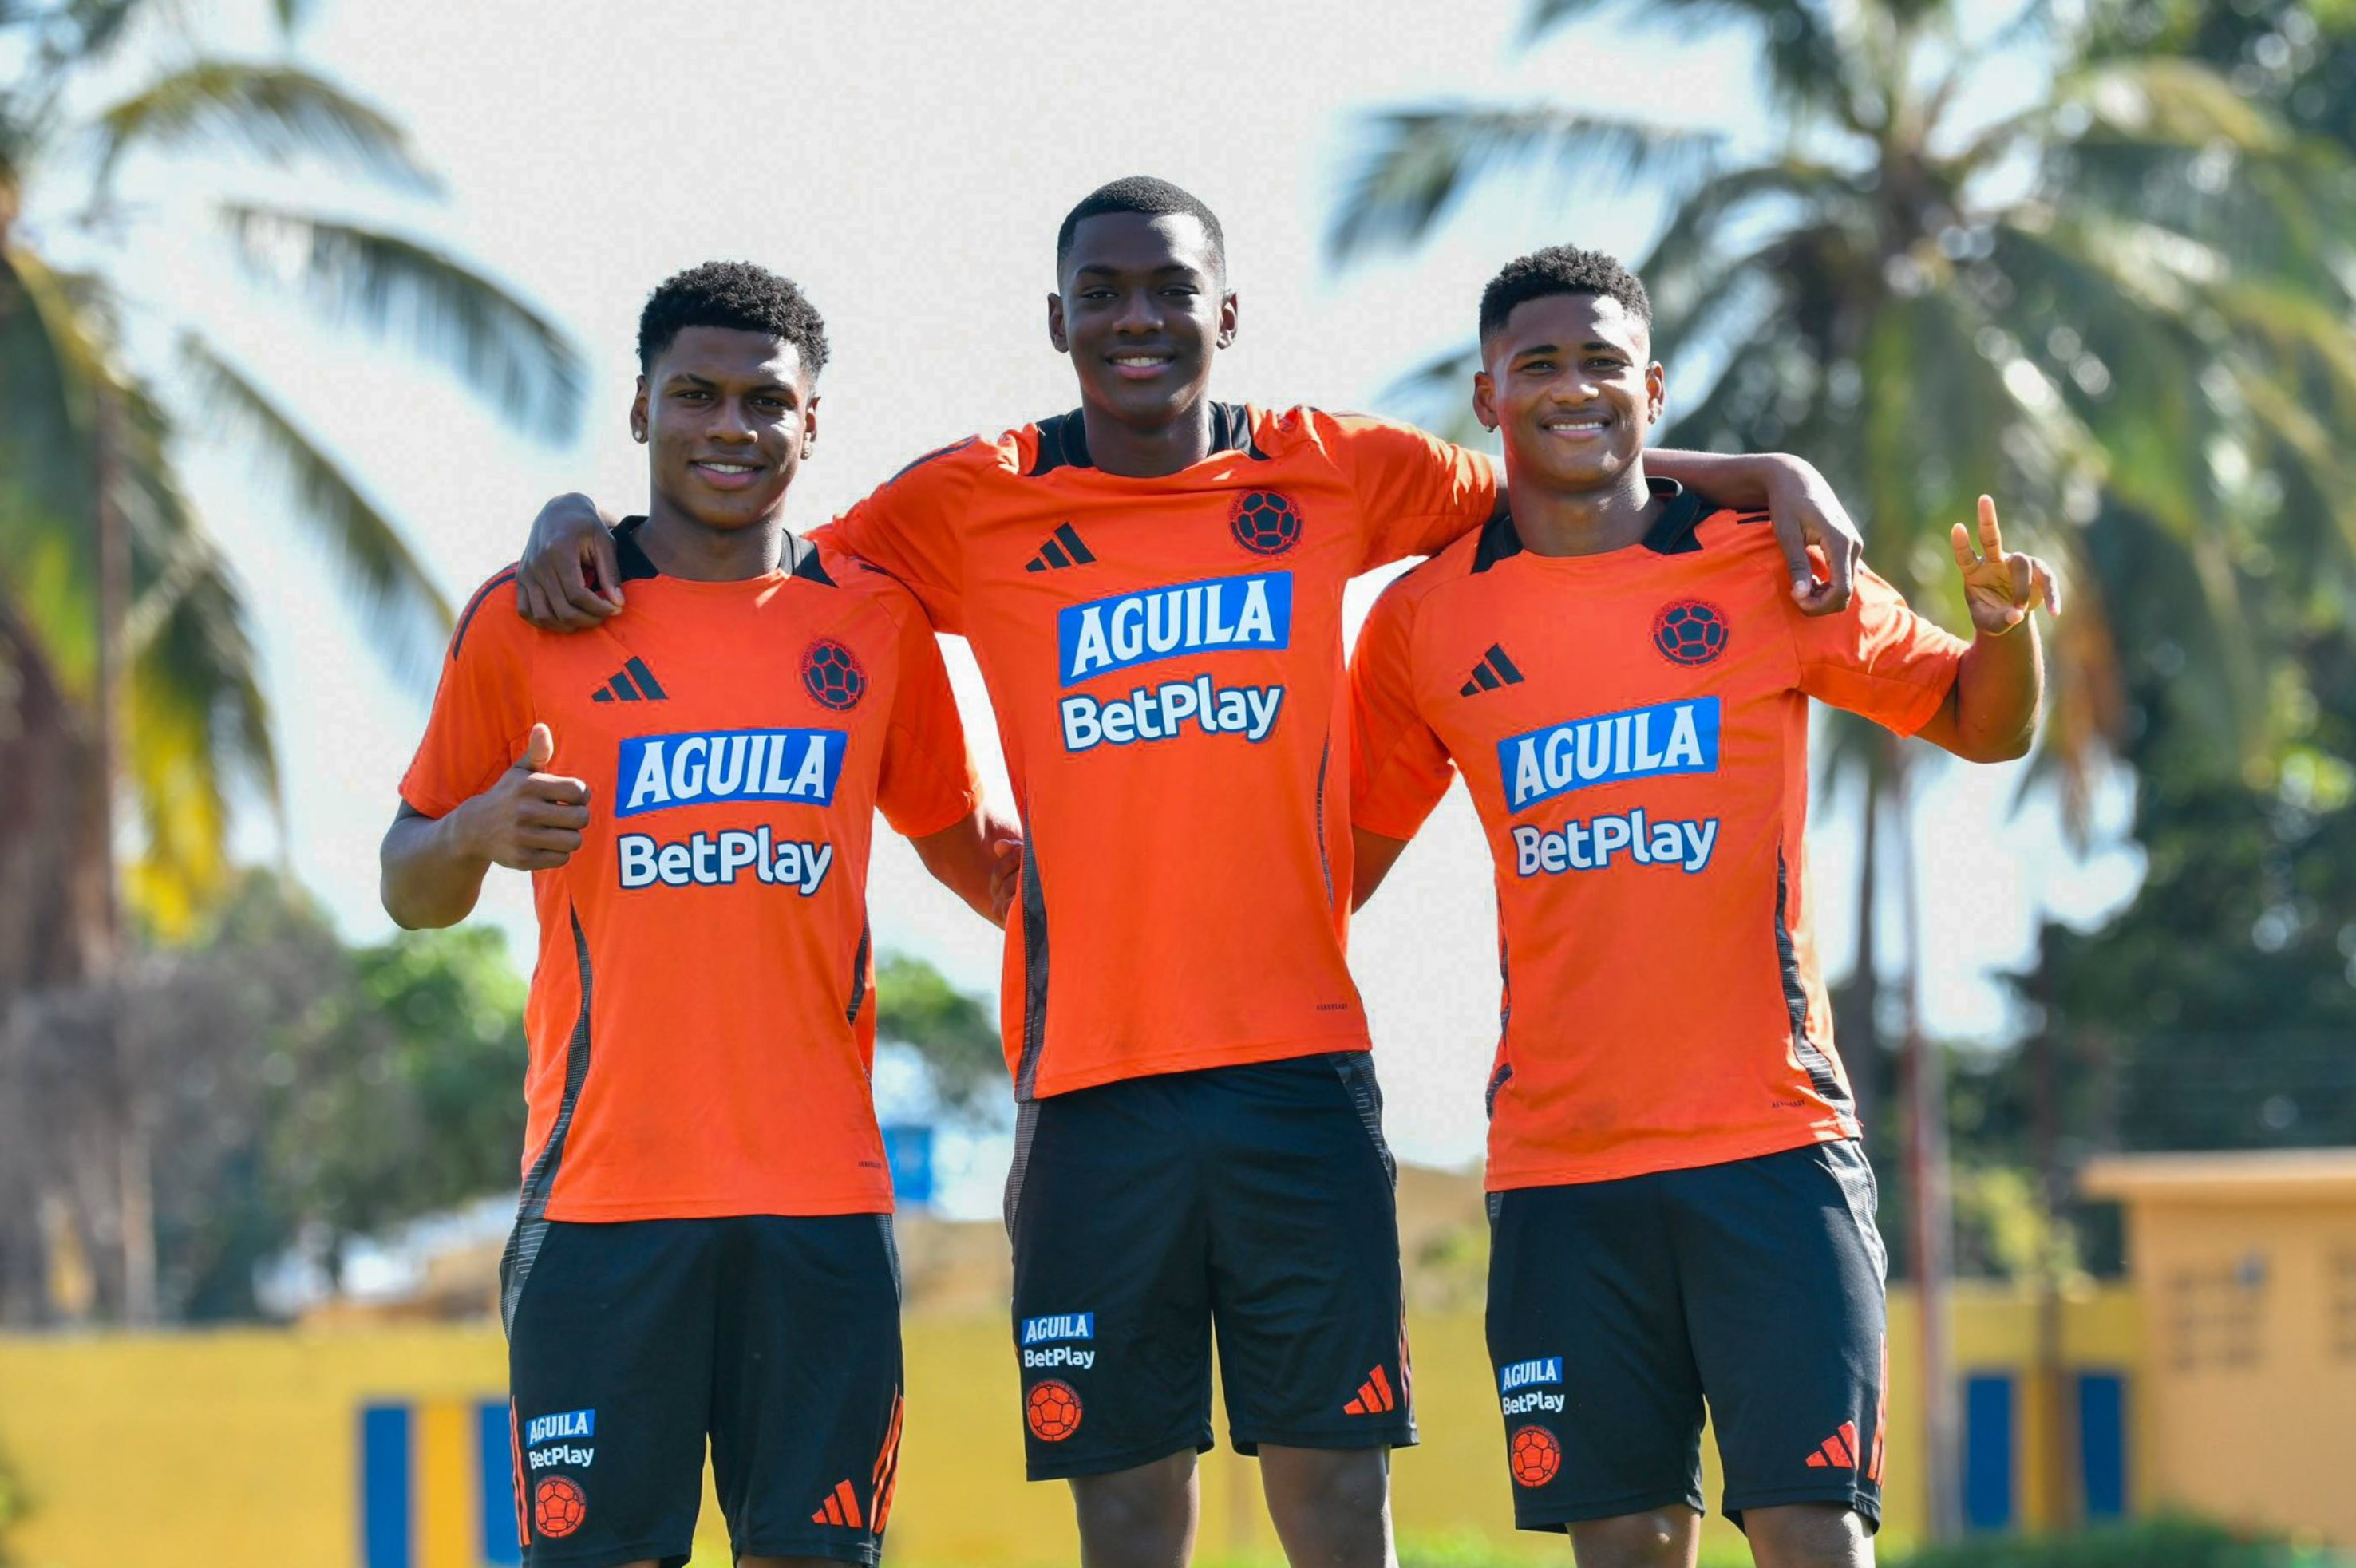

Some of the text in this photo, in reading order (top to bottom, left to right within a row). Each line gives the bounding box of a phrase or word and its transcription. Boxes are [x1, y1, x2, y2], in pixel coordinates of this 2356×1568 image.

[1070, 579, 1276, 677] AGUILA
[1060, 675, 1283, 751] BetPlay
[626, 735, 827, 809] AGUILA
[1514, 705, 1705, 806] AGUILA
[618, 826, 832, 895] BetPlay
[1512, 808, 1718, 875] BetPlay
[1024, 1315, 1089, 1343] AGUILA
[1024, 1346, 1095, 1369] BetPlay
[1503, 1359, 1557, 1392] AGUILA
[529, 1412, 589, 1444] AGUILA
[1502, 1391, 1565, 1415] BetPlay
[528, 1444, 595, 1469] BetPlay
